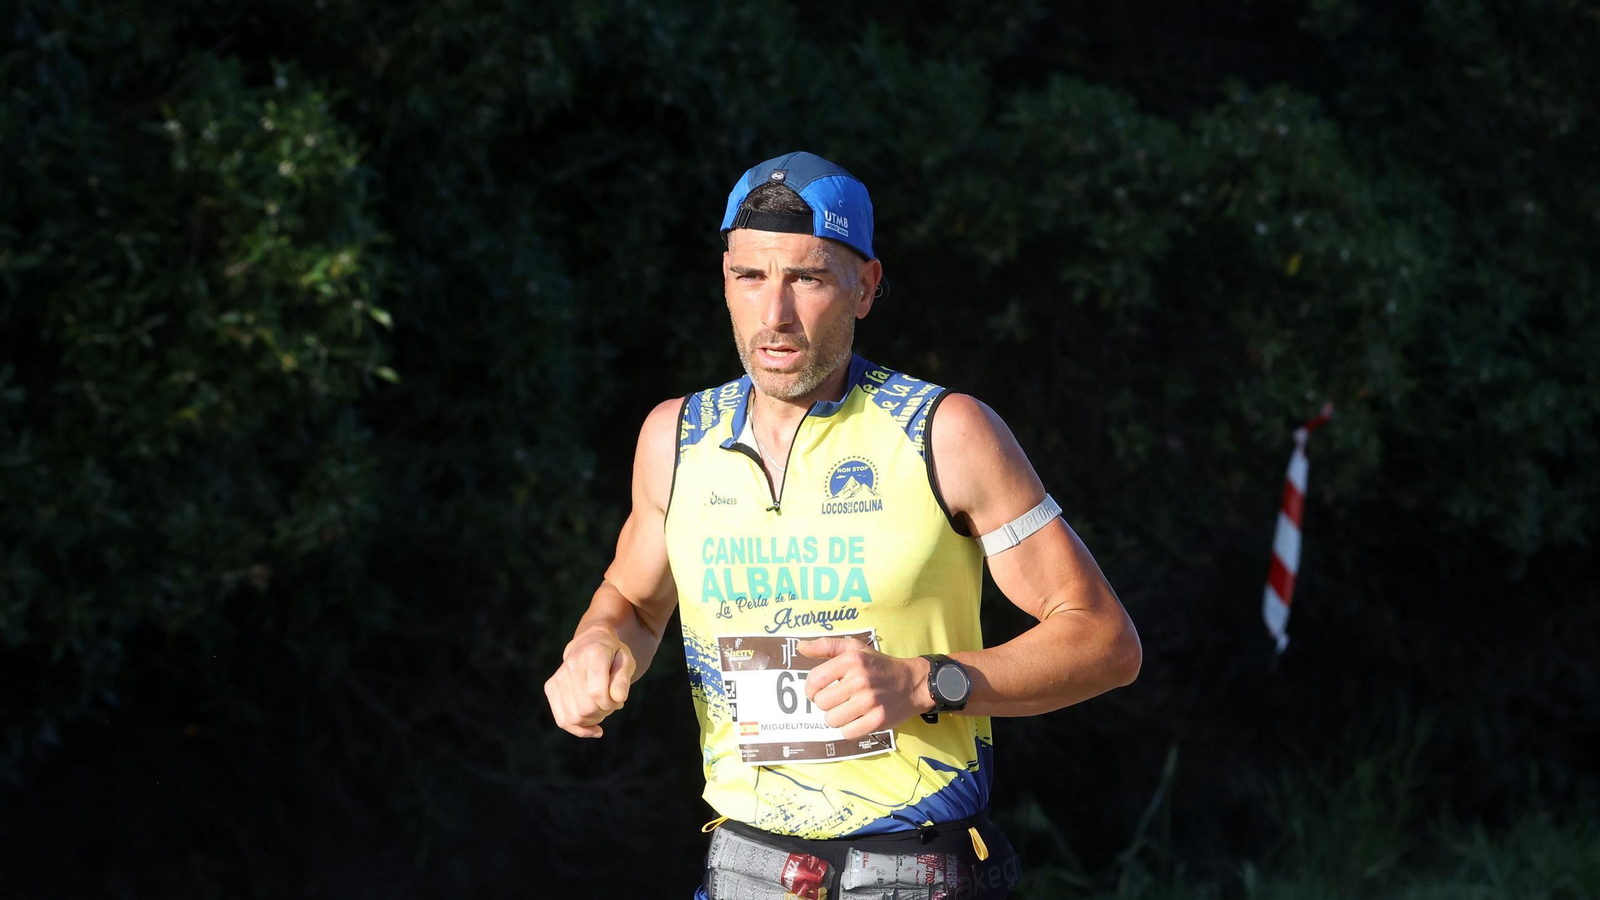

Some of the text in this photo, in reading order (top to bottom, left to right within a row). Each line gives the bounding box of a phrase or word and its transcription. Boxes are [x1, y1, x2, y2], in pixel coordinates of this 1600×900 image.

[825, 211, 849, 229] UTMB
[822, 502, 848, 514] LOCOS
[853, 499, 883, 513] COLINA
[702, 536, 865, 565] CANILLAS DE
[702, 566, 872, 603] ALBAIDA
[716, 591, 797, 619] La Perla de la
[765, 606, 859, 634] Axarquía
[725, 649, 754, 657] Sherry
